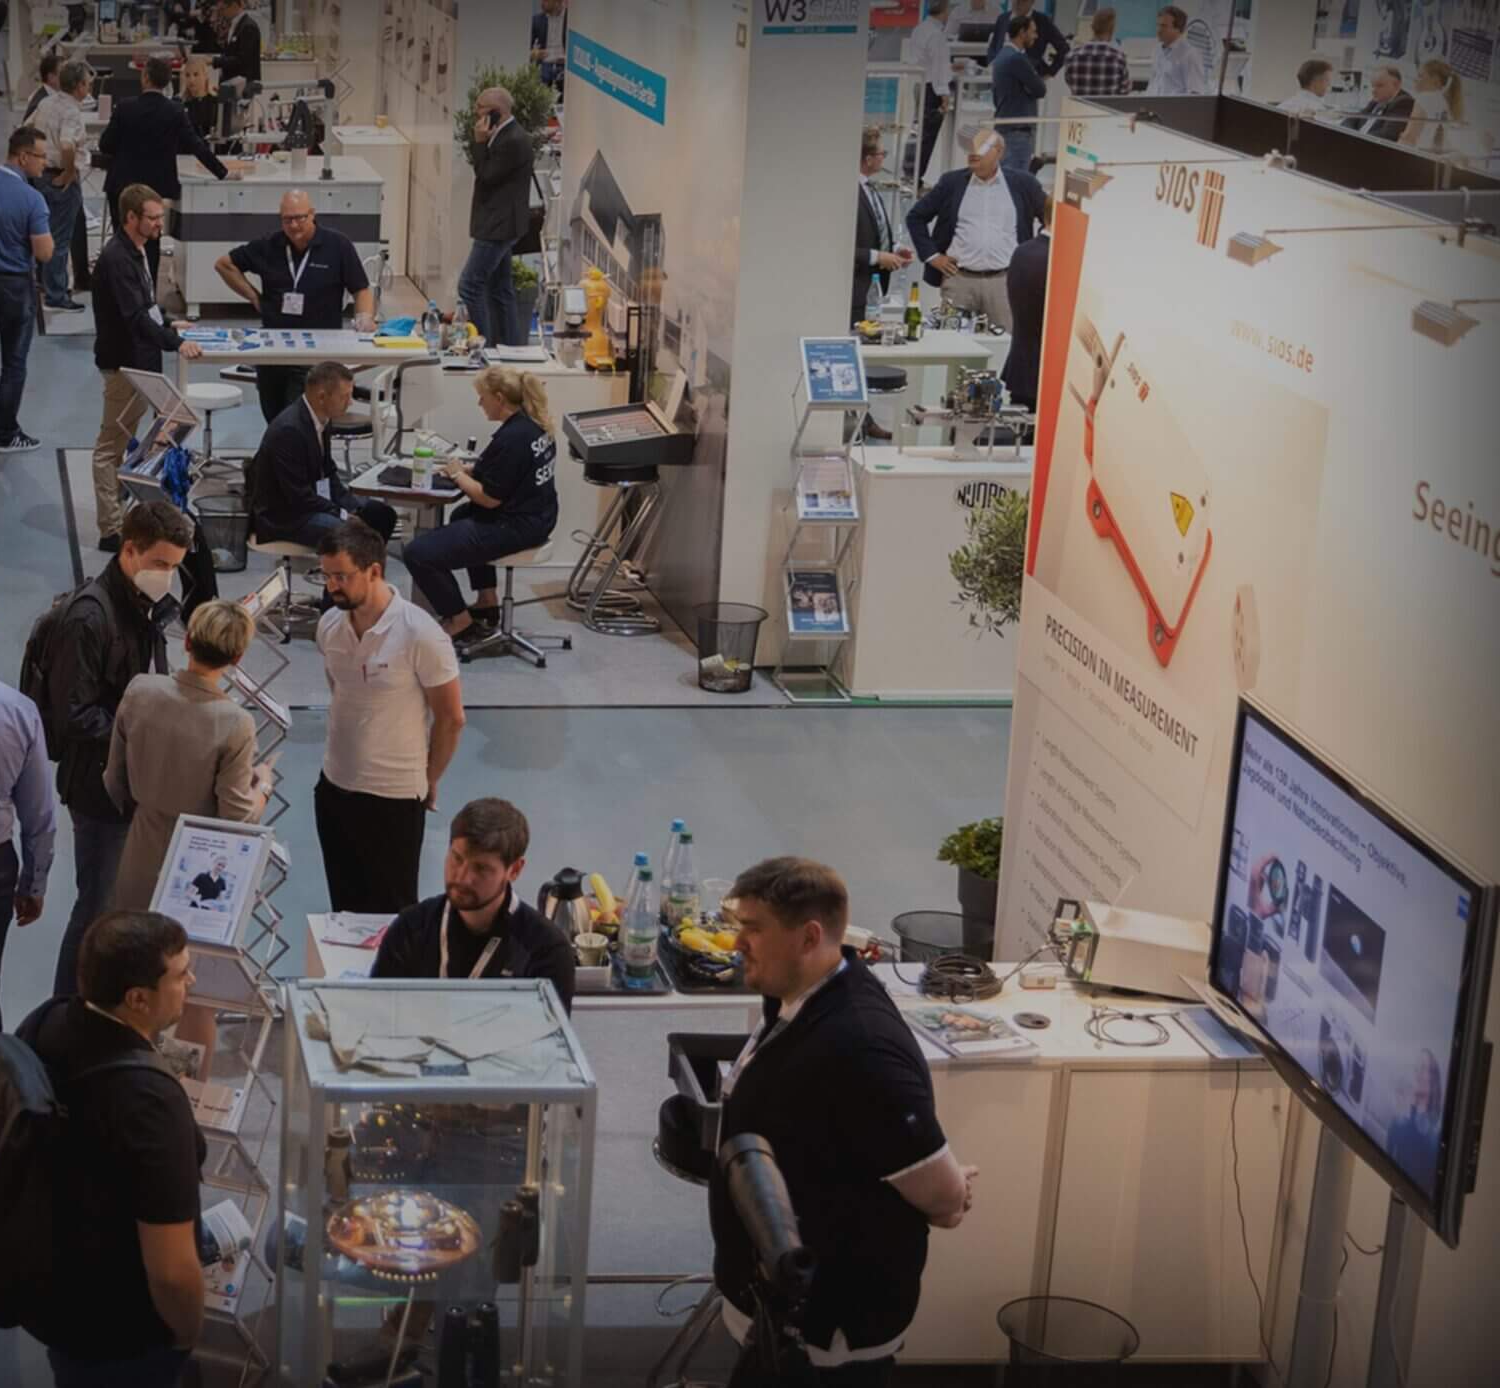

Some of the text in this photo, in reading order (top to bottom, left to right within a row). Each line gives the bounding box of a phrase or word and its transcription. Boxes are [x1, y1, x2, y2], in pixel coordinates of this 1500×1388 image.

[1156, 163, 1199, 214] SIOS
[1229, 319, 1314, 374] www.sios.de
[1045, 614, 1098, 675] PRECISION
[1098, 657, 1112, 687] IN
[1113, 671, 1198, 758] MEASUREMENT
[1310, 794, 1360, 847] Innovationen
